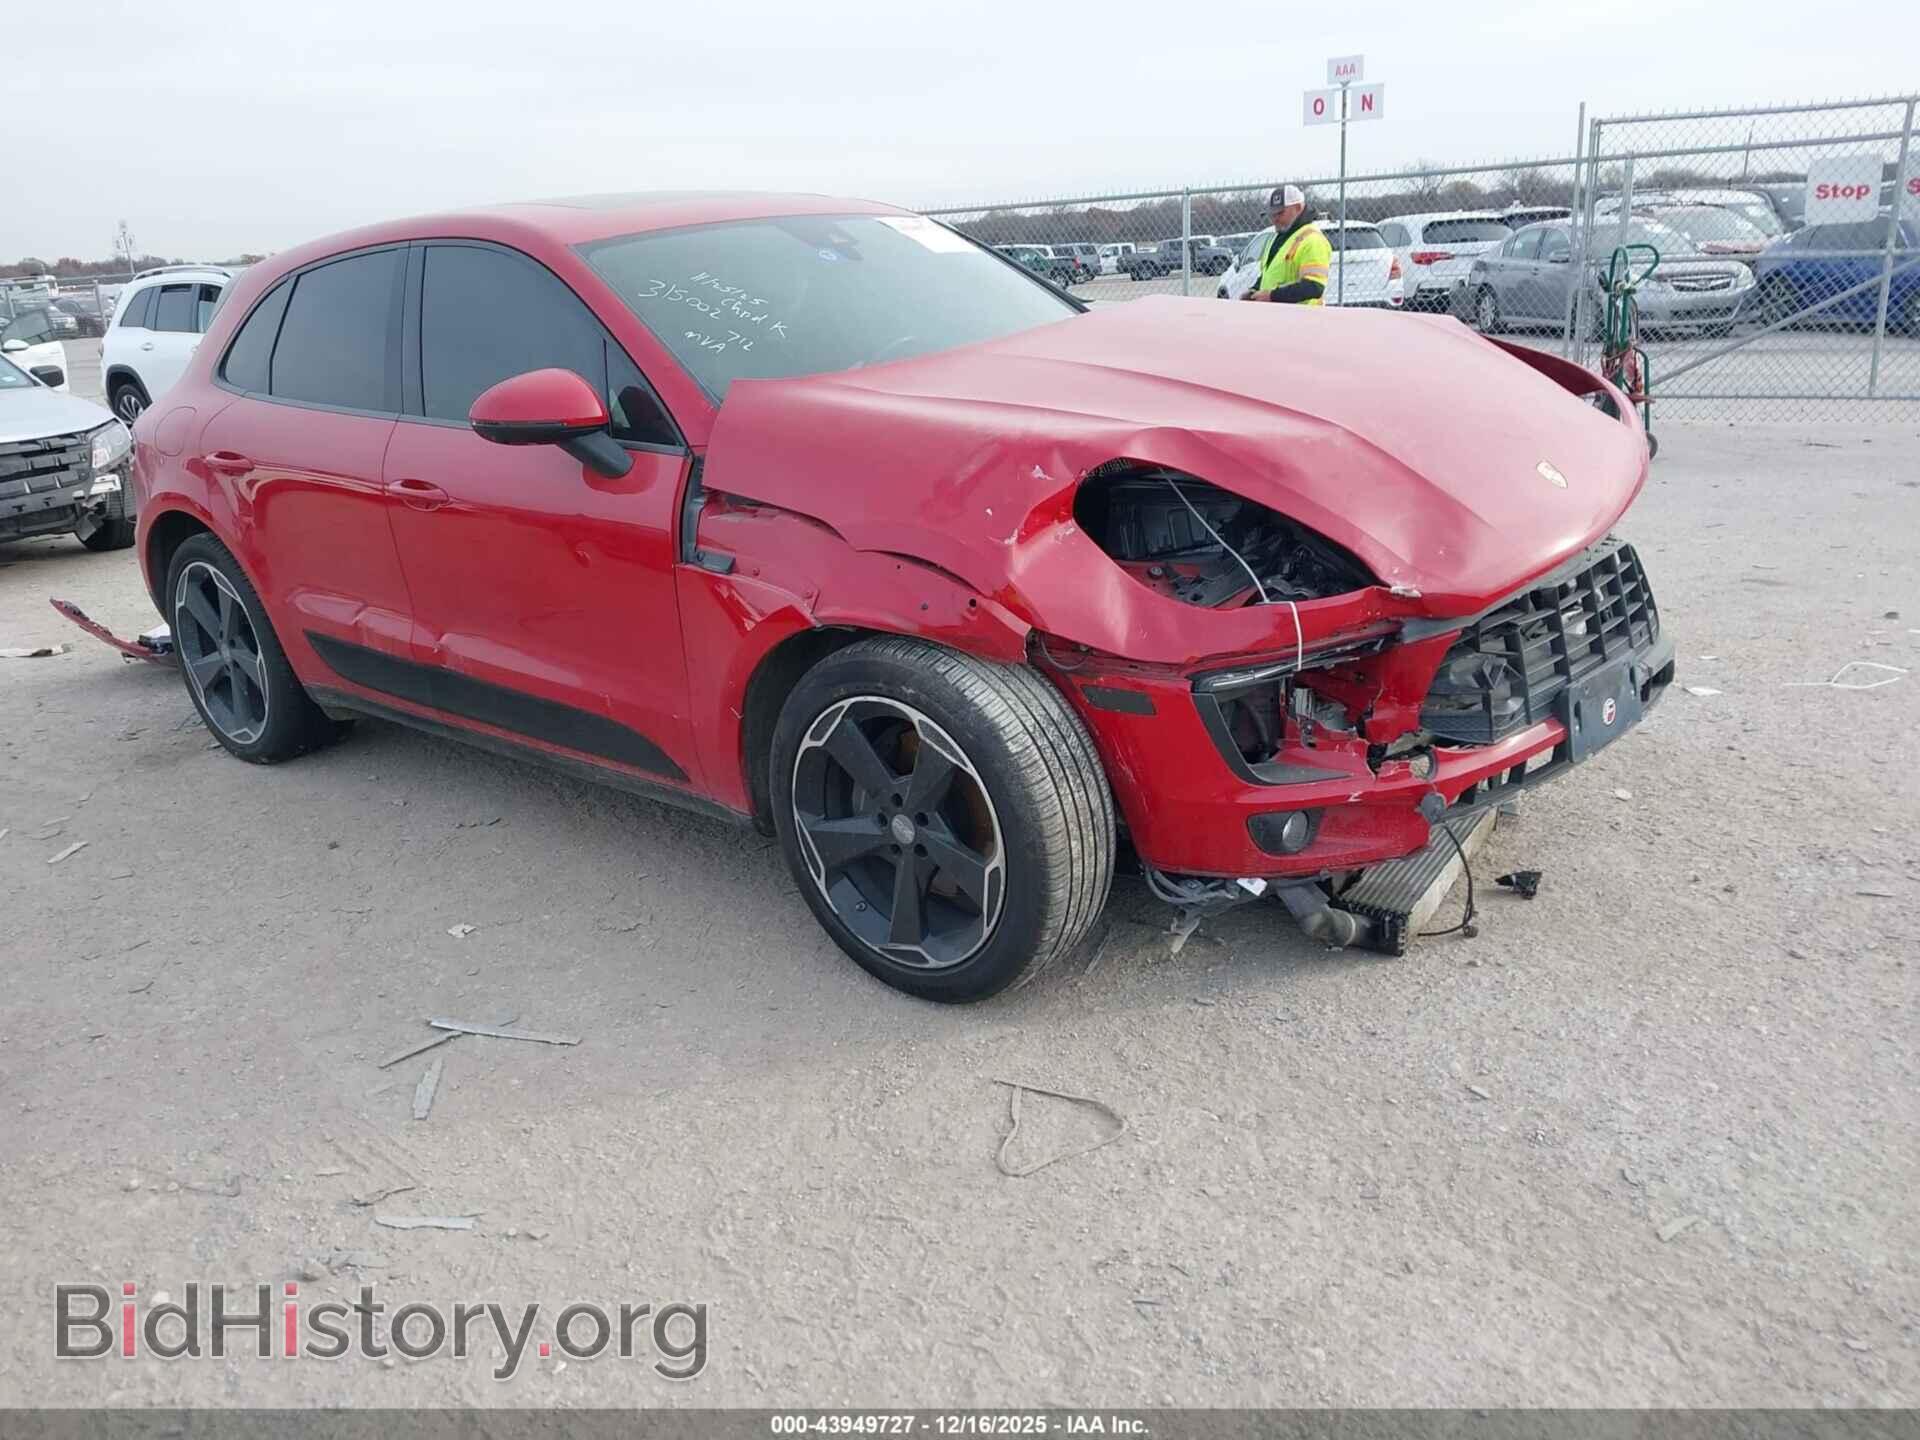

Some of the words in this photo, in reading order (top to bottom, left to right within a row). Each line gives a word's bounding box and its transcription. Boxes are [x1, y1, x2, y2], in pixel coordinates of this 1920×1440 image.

[1312, 97, 1325, 116] O
[1361, 93, 1373, 112] N
[1816, 183, 1871, 200] Stop
